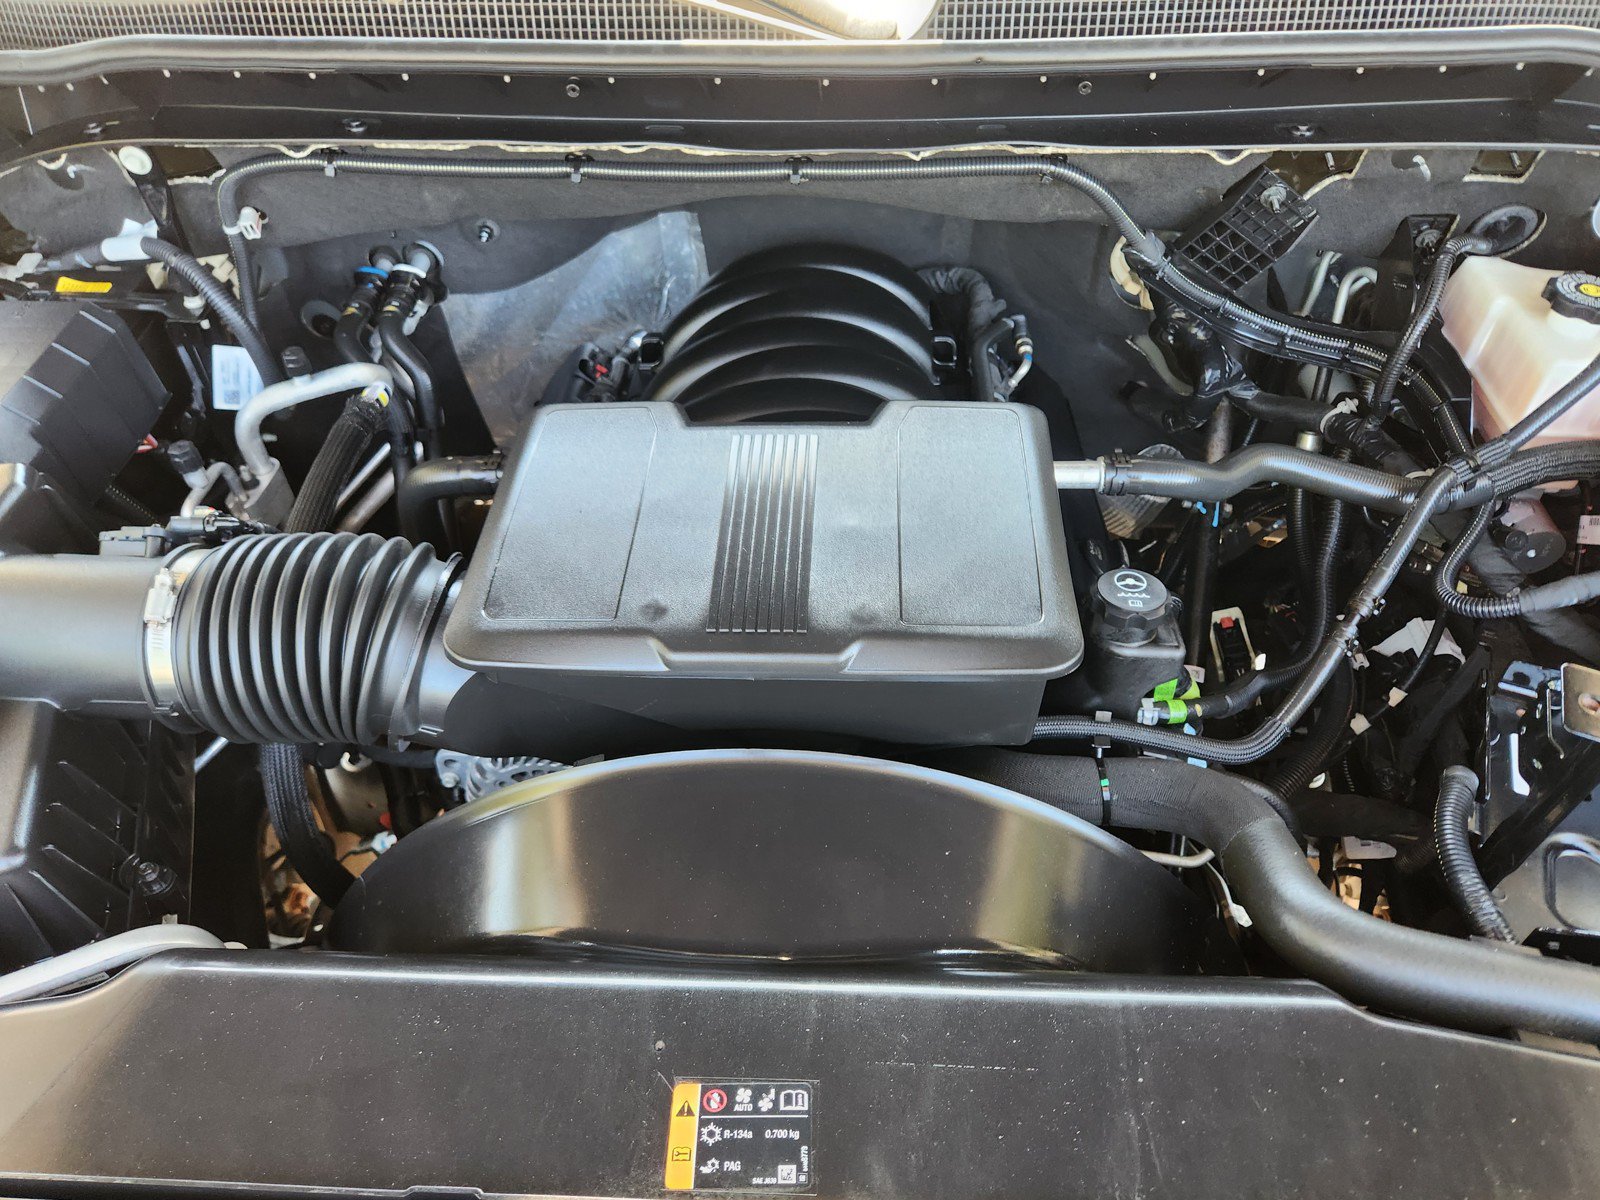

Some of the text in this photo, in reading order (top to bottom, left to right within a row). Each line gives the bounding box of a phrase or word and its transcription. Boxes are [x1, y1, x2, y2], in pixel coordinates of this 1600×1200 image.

[733, 1103, 753, 1112] AUTO
[723, 1129, 800, 1140] R-134a 0.700 kg
[723, 1161, 741, 1171] PAG
